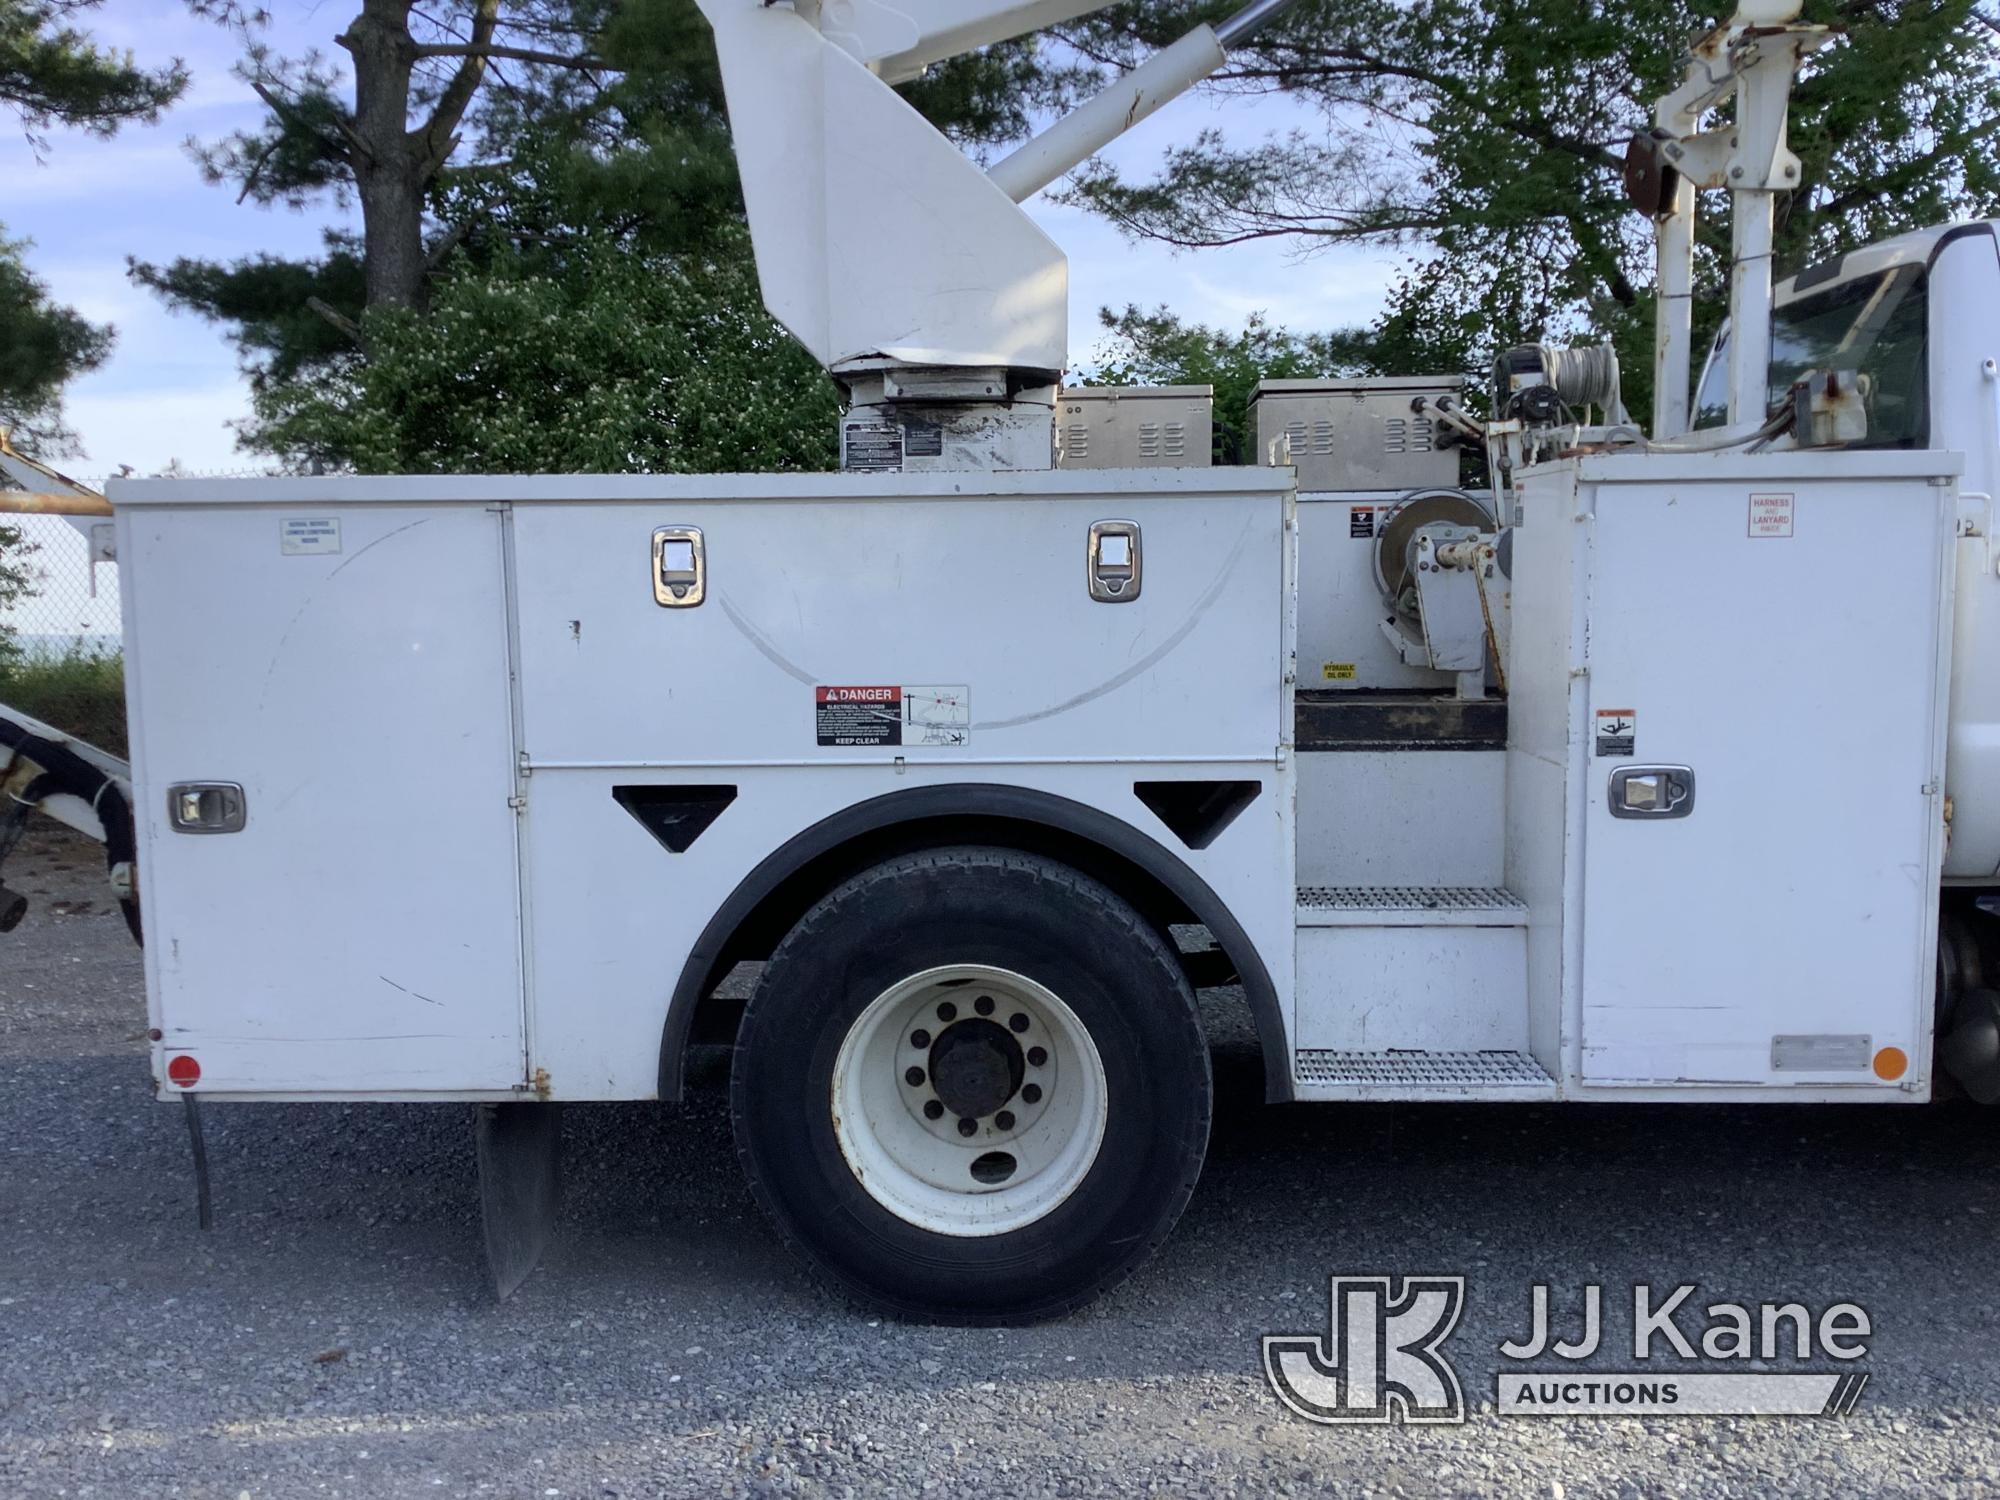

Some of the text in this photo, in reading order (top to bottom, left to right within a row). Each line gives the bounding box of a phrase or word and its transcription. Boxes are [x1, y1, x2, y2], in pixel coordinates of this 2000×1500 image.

[1753, 499, 1789, 507] HARNESS
[1753, 516, 1789, 524] LANYARD
[839, 689, 892, 700] DANGER
